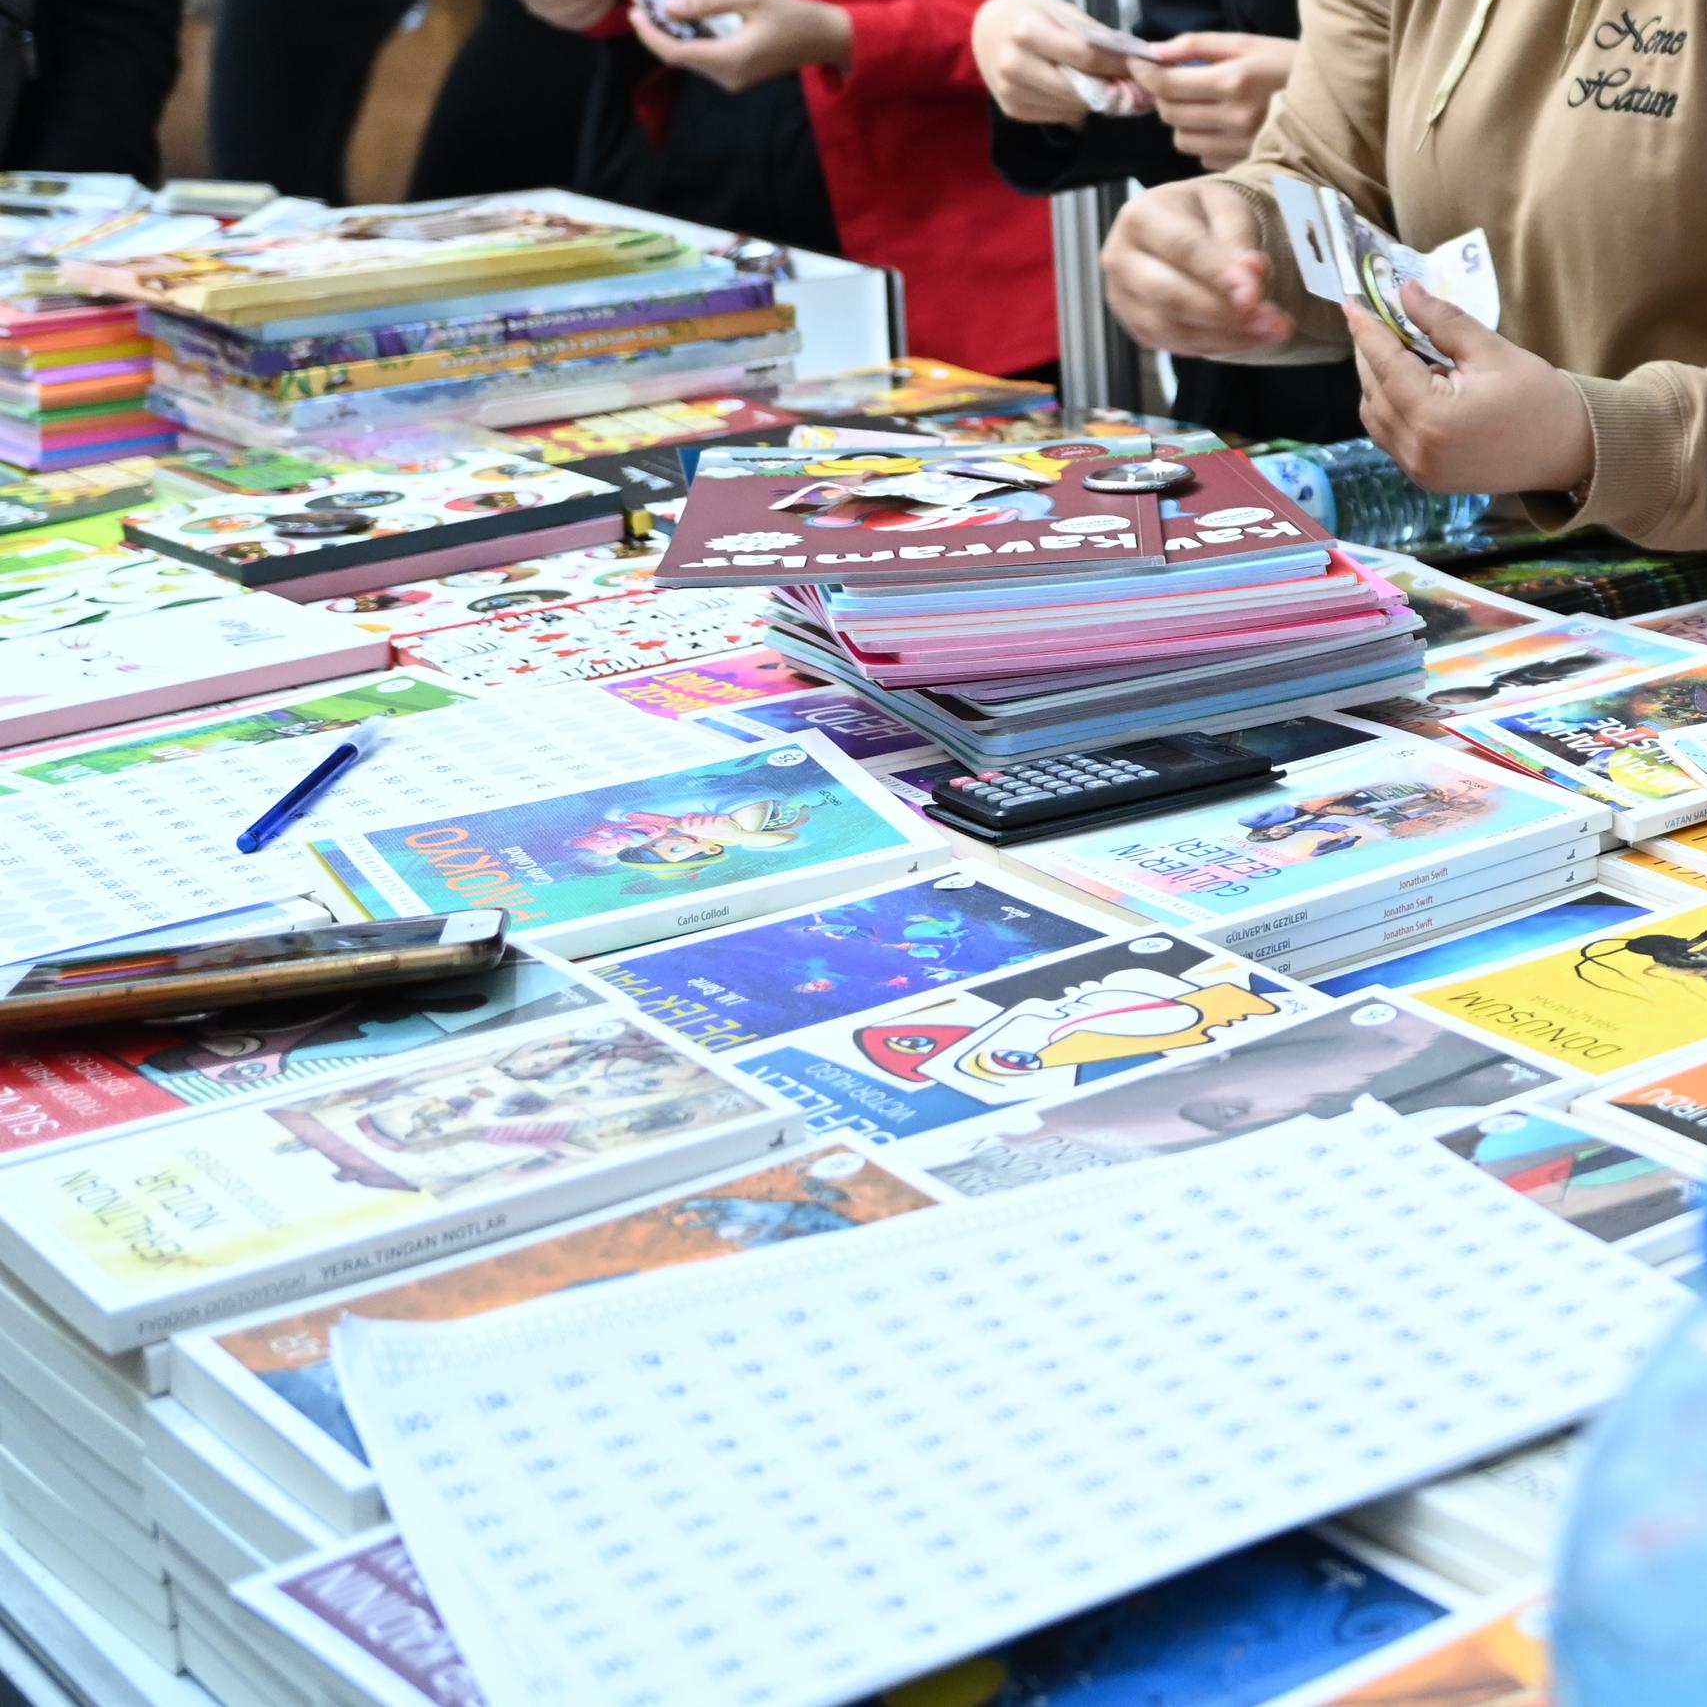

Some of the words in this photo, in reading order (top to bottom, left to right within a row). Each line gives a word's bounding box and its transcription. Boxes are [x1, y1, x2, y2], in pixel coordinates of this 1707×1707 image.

[1567, 68, 1679, 118] Hatun
[795, 704, 912, 741] HEIDI
[1515, 712, 1614, 757] YAHUT
[1664, 814, 1692, 829] VATAN
[1109, 842, 1249, 899] GÜLİVER'İN
[1167, 837, 1282, 881] GEZİLERİ
[678, 912, 707, 926] Carlo
[705, 906, 730, 920] Collodi
[1272, 909, 1308, 930] GEZİLERİ
[1399, 872, 1429, 890] Jonathan
[1427, 867, 1448, 881] Swift
[1383, 901, 1414, 918] Jonathan
[1412, 895, 1433, 909] Swift
[1383, 923, 1413, 941] Jonathan
[1411, 918, 1433, 932] Swift
[588, 965, 662, 1010] PAN
[653, 995, 759, 1053] PETER
[1447, 988, 1623, 1060] DÖNÜŞÜM
